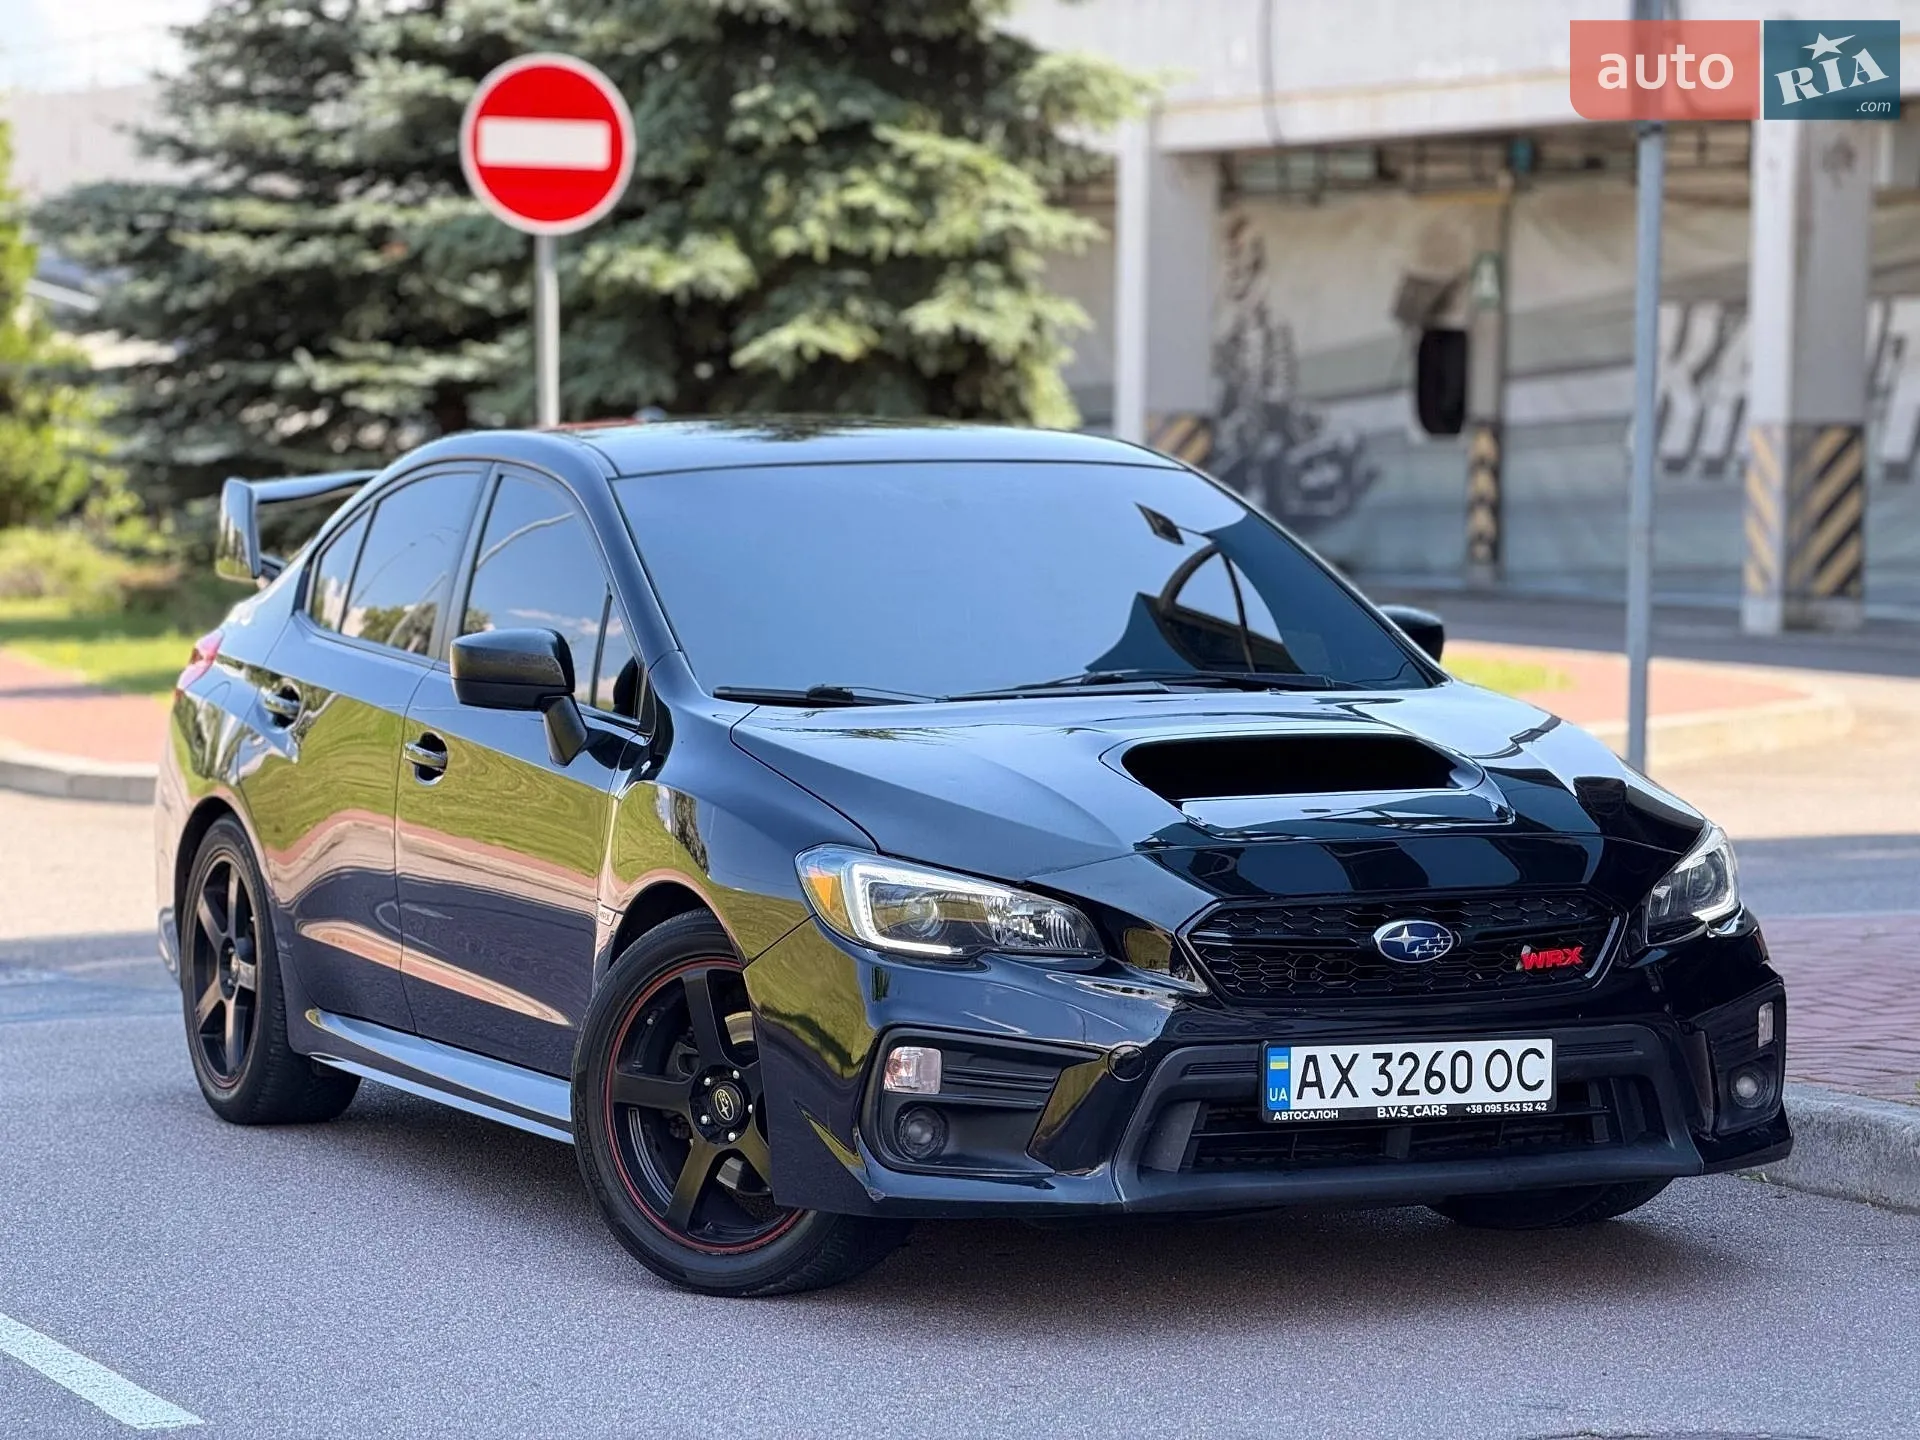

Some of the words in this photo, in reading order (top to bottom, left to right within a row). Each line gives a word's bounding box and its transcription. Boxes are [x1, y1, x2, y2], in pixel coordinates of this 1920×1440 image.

[1521, 946, 1583, 970] WRX
[1296, 1053, 1360, 1100] AX
[1371, 1050, 1474, 1097] 3260
[1484, 1047, 1546, 1093] OC
[1269, 1088, 1288, 1101] UA
[1376, 1105, 1448, 1118] B.V.S_CARS
[1465, 1105, 1482, 1114] +38
[1484, 1104, 1502, 1113] 095
[1503, 1103, 1521, 1113] 543
[1522, 1103, 1534, 1112] 52
[1534, 1102, 1548, 1112] 42
[1273, 1110, 1339, 1120] АВТОСАЛОН
